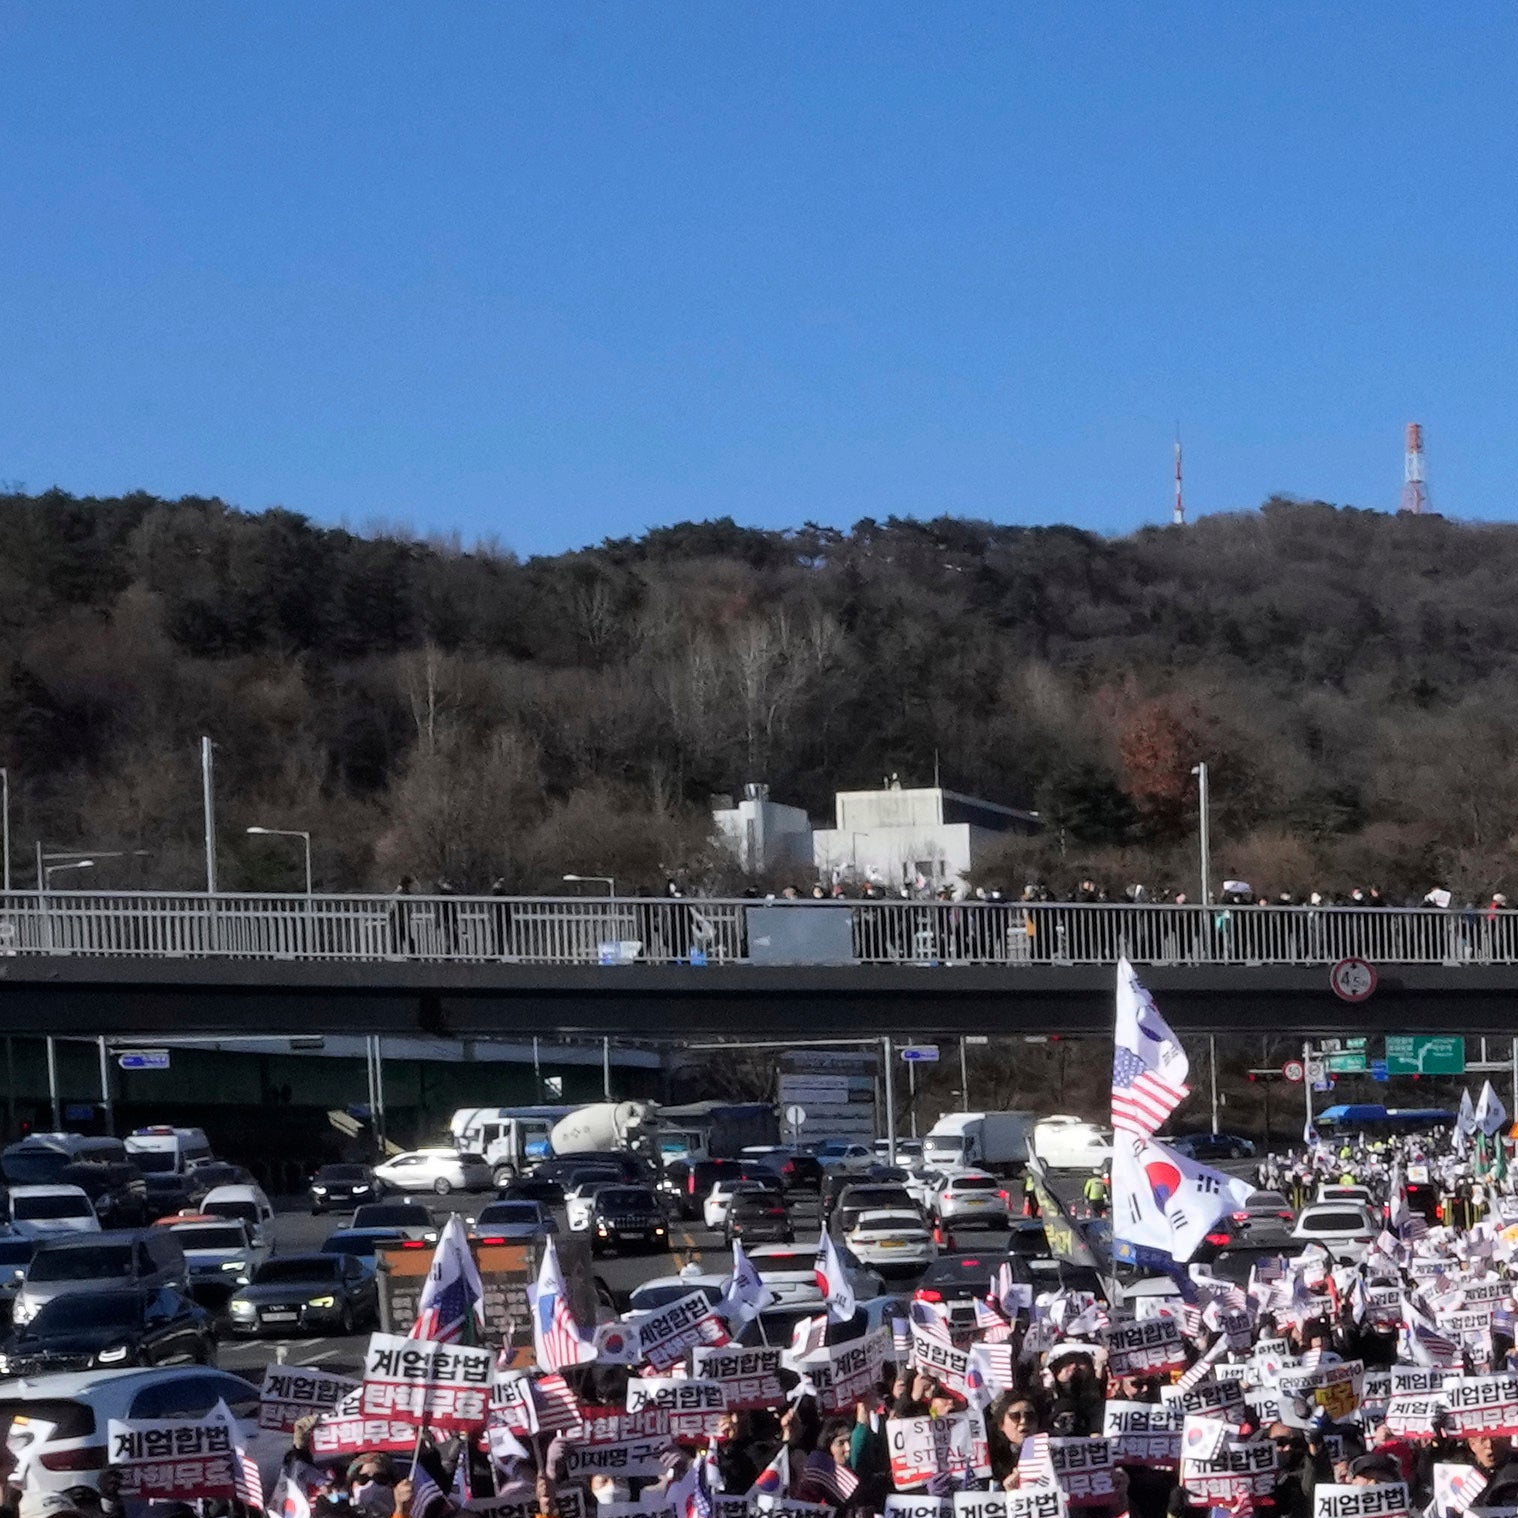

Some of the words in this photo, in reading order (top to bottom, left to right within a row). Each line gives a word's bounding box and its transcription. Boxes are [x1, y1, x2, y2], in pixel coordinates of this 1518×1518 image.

[372, 1350, 490, 1383] 계엄합법
[361, 1388, 484, 1421] 탄핵무효
[115, 1425, 229, 1456] 계엄합법
